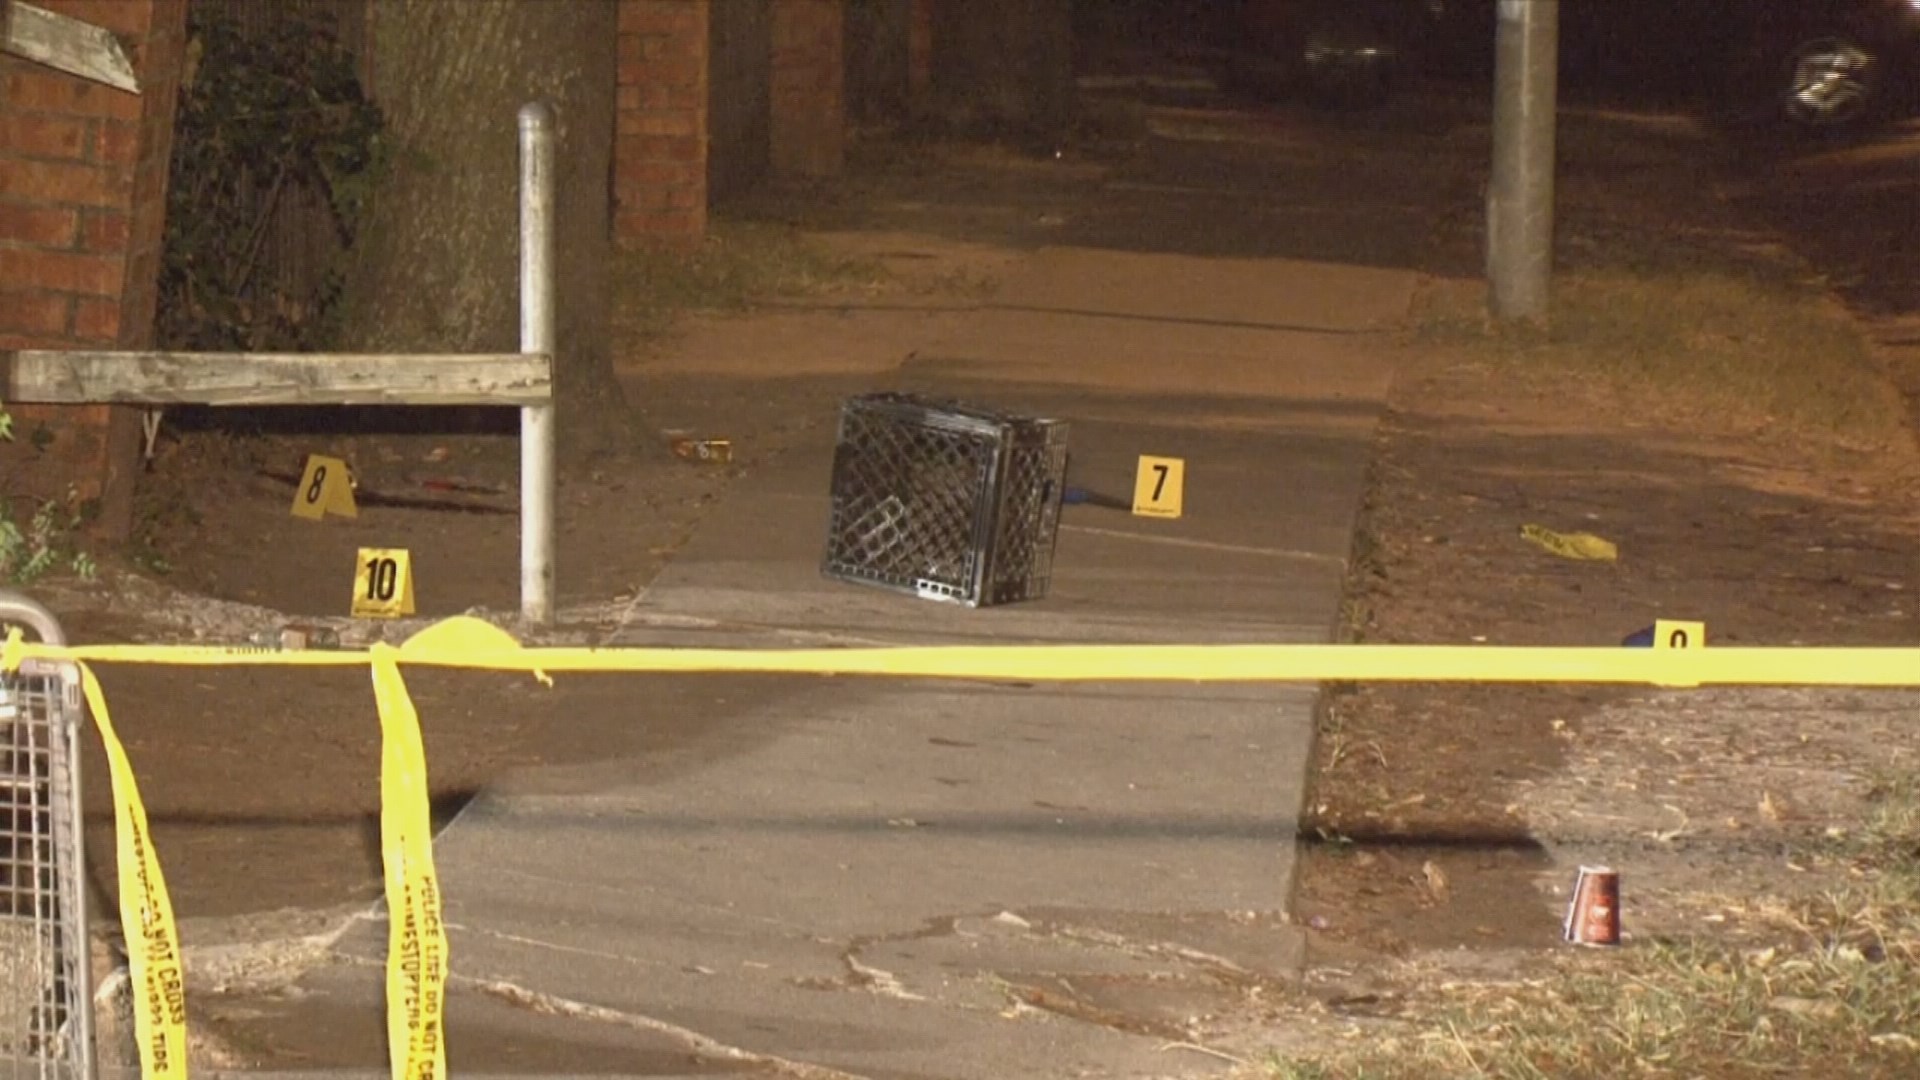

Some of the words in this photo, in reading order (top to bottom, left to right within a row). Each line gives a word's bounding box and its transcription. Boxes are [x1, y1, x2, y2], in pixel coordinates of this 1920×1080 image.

[307, 465, 326, 504] 8
[1151, 464, 1169, 502] 7
[366, 557, 397, 602] 10
[421, 876, 439, 937] POLICE
[155, 928, 174, 962] NOT
[425, 945, 440, 983] LINE
[158, 967, 185, 1025] CROSS
[425, 989, 438, 1014] DO
[152, 1032, 168, 1073] TIPS
[422, 1020, 437, 1055] NOT
